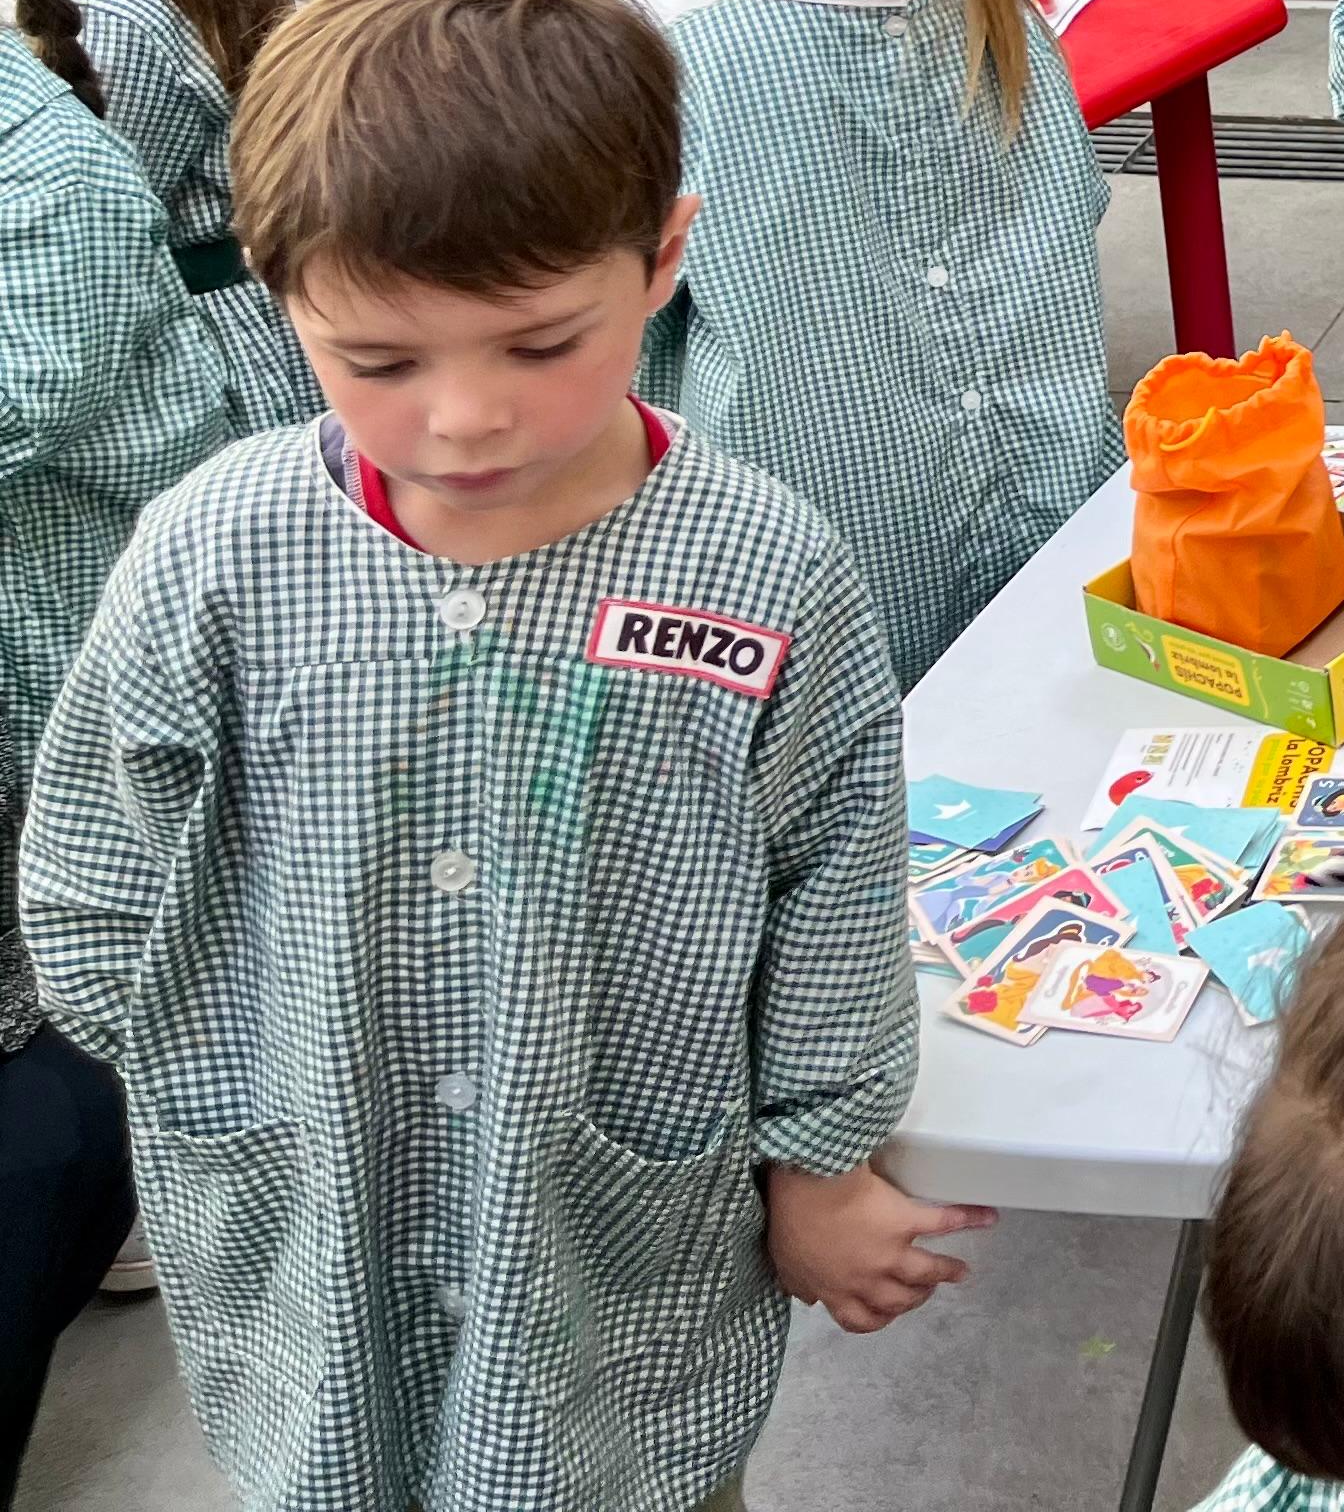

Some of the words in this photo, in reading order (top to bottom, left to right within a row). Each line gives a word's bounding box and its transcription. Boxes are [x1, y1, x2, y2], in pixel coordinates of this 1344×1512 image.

[616, 612, 765, 676] RENZO
[1286, 738, 1307, 751] la
[1267, 754, 1297, 805] lombriz
